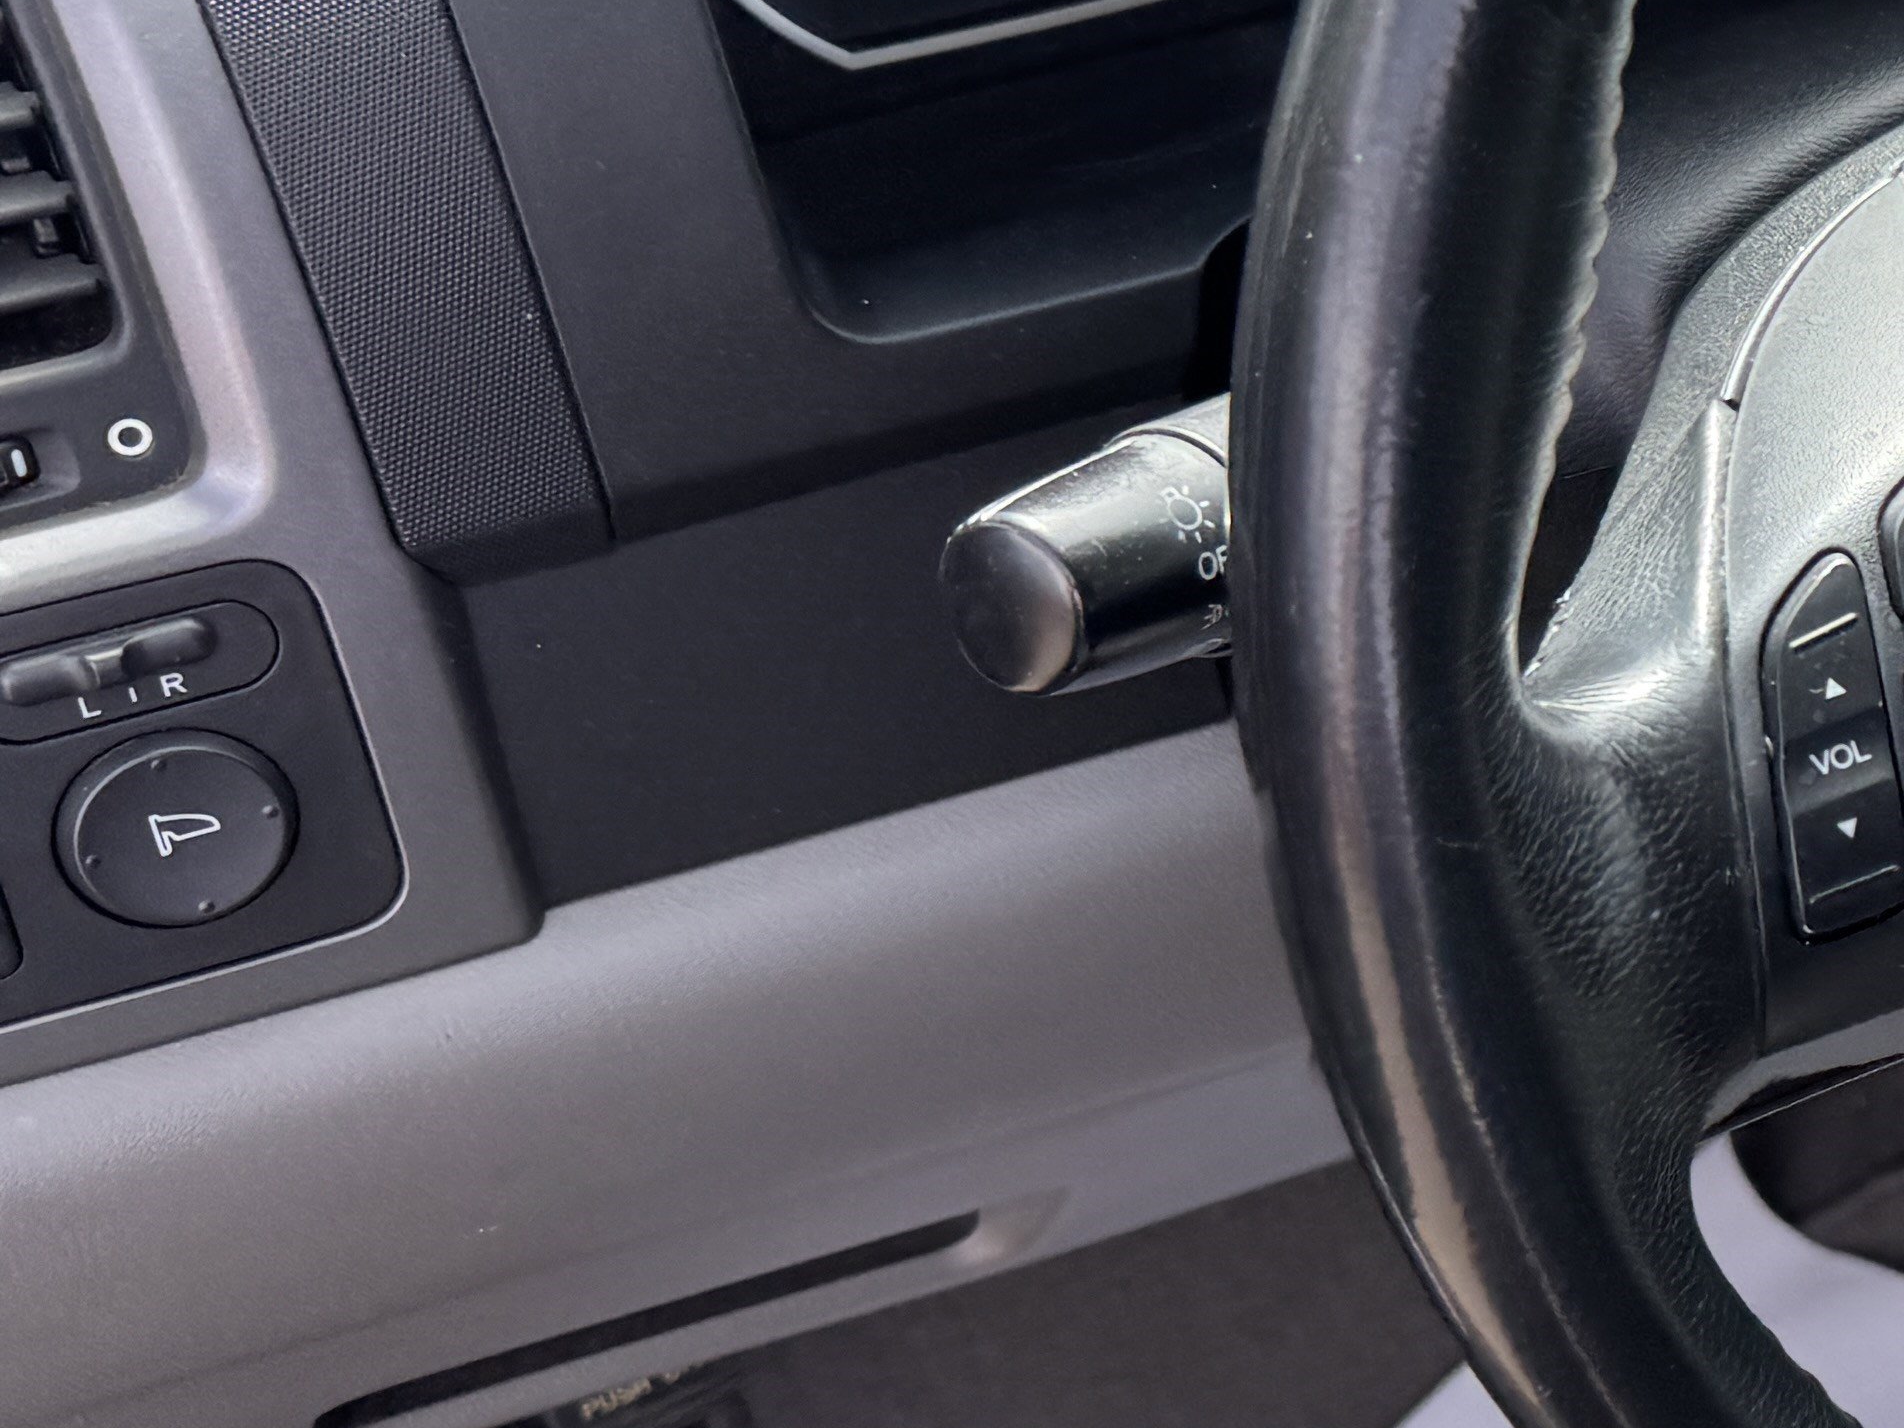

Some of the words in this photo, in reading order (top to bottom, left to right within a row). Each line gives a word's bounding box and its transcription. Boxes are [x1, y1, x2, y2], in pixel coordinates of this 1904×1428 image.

[77, 696, 103, 719] L
[159, 671, 189, 697] R
[1809, 739, 1873, 776] VOL
